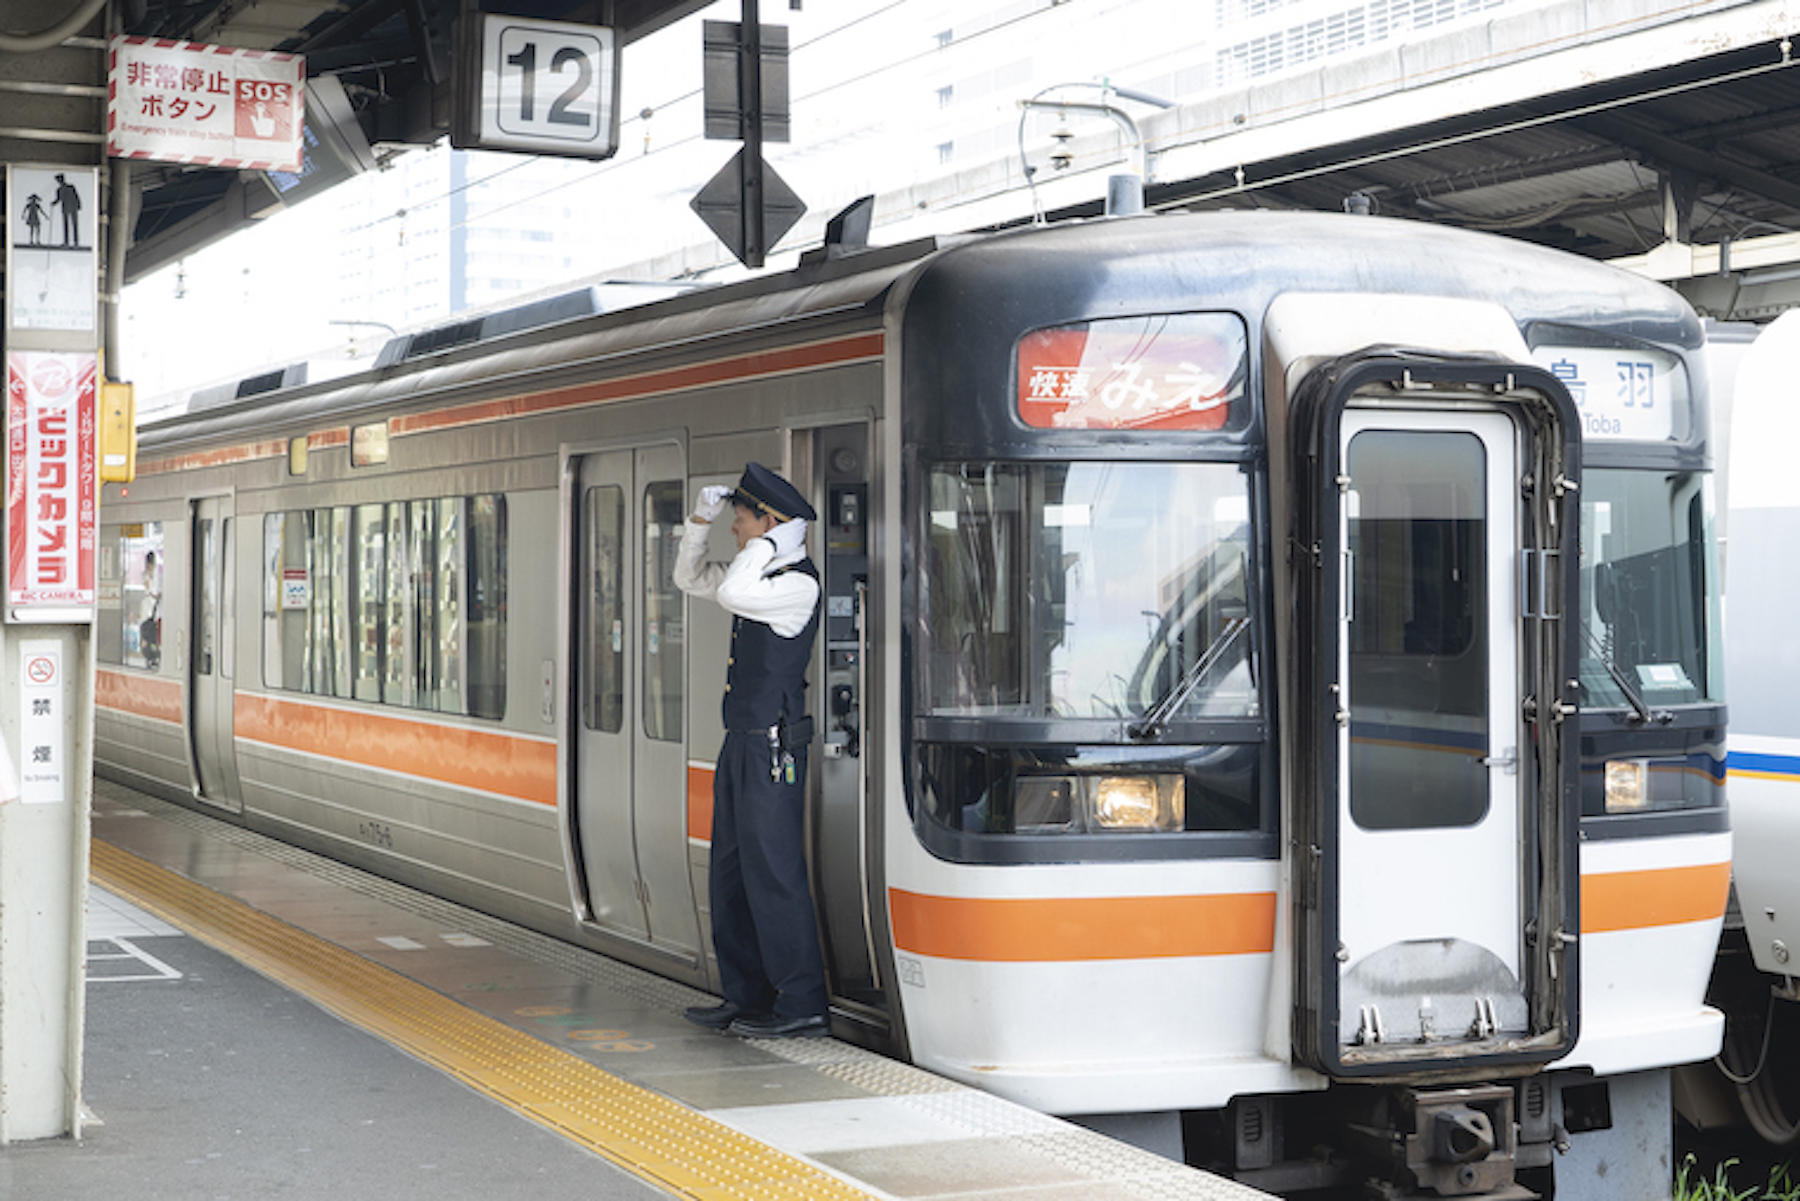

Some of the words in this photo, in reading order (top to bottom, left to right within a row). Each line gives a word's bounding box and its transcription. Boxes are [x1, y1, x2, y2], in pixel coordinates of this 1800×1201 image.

[127, 61, 231, 96] 非常停止
[240, 81, 289, 102] SOS
[505, 42, 594, 127] 12
[141, 94, 217, 121] ボタン
[1029, 370, 1090, 398] 快速
[1101, 361, 1222, 410] みえ
[1551, 357, 1654, 408] 鳥羽
[1583, 412, 1621, 433] Toba
[38, 407, 67, 583] ビックカメラ
[40, 591, 84, 601] CAMERA
[33, 699, 51, 762] 禁煙
